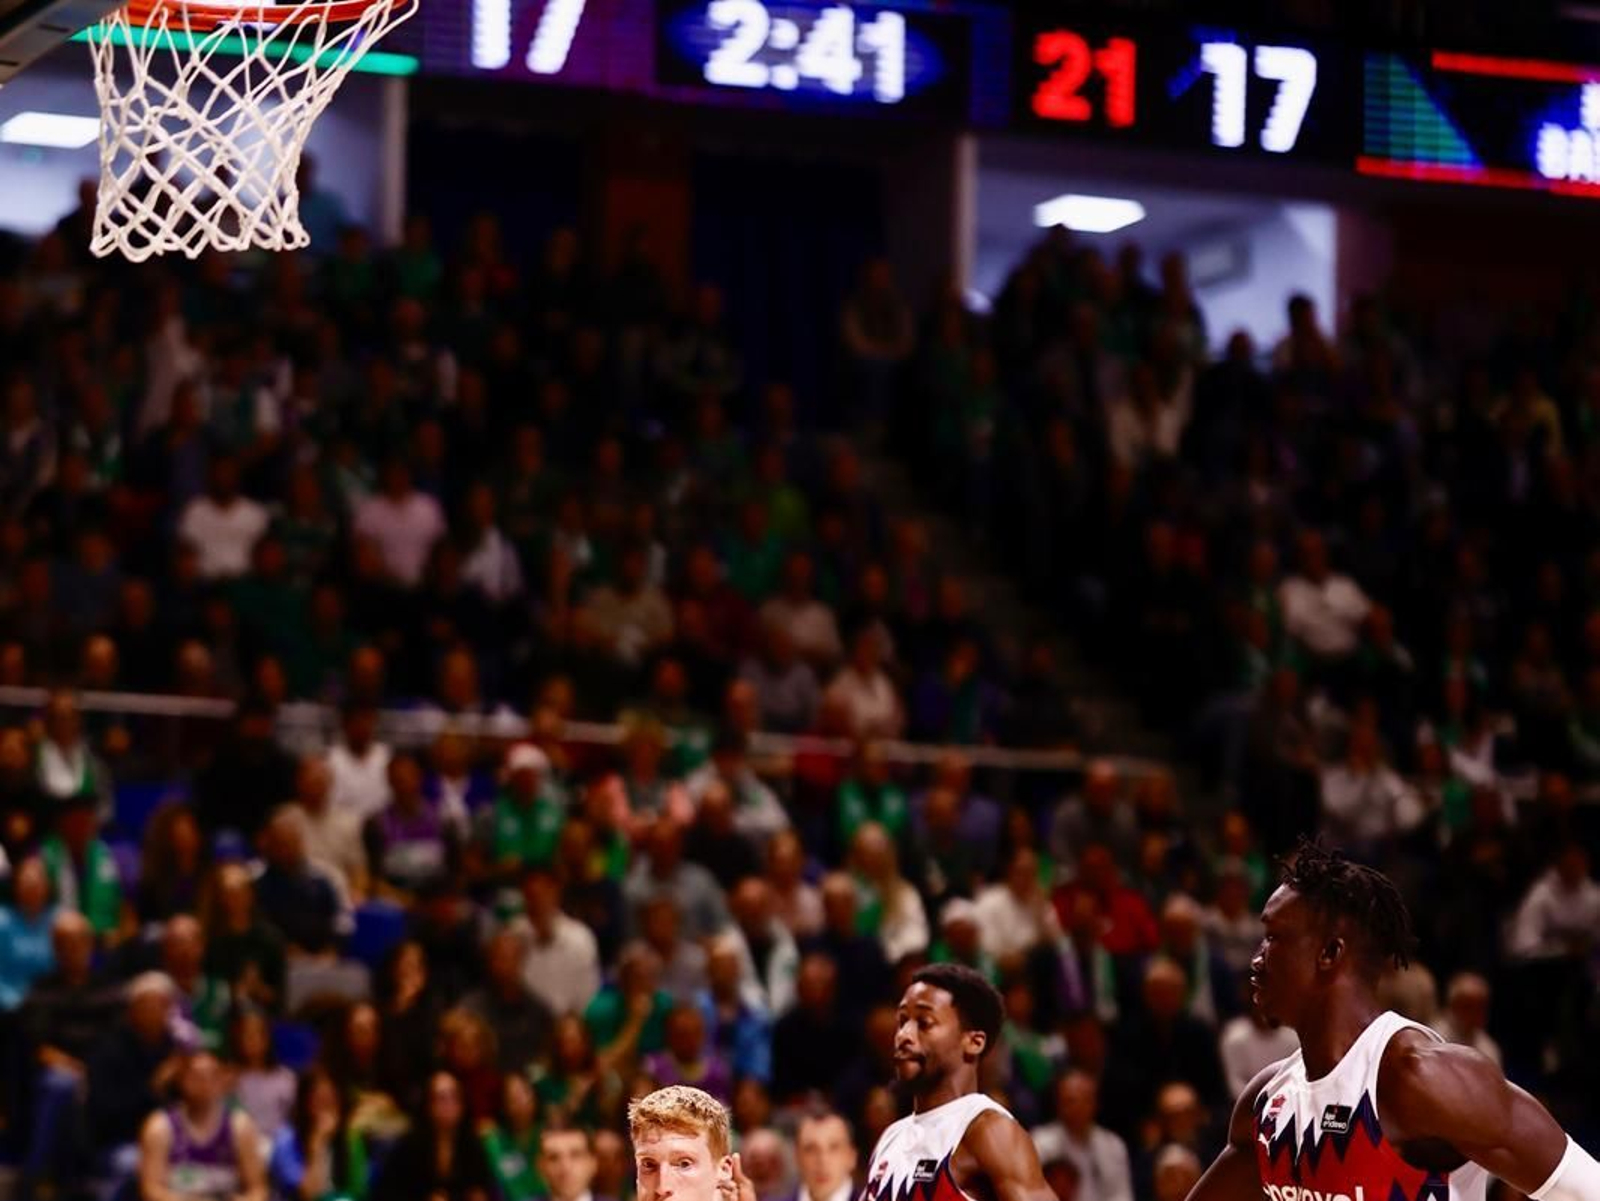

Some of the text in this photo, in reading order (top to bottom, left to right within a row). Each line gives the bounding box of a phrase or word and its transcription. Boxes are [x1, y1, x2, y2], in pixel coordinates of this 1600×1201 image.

[703, 0, 905, 102] 2:41
[1033, 29, 1136, 127] 21
[1201, 42, 1317, 153] 17
